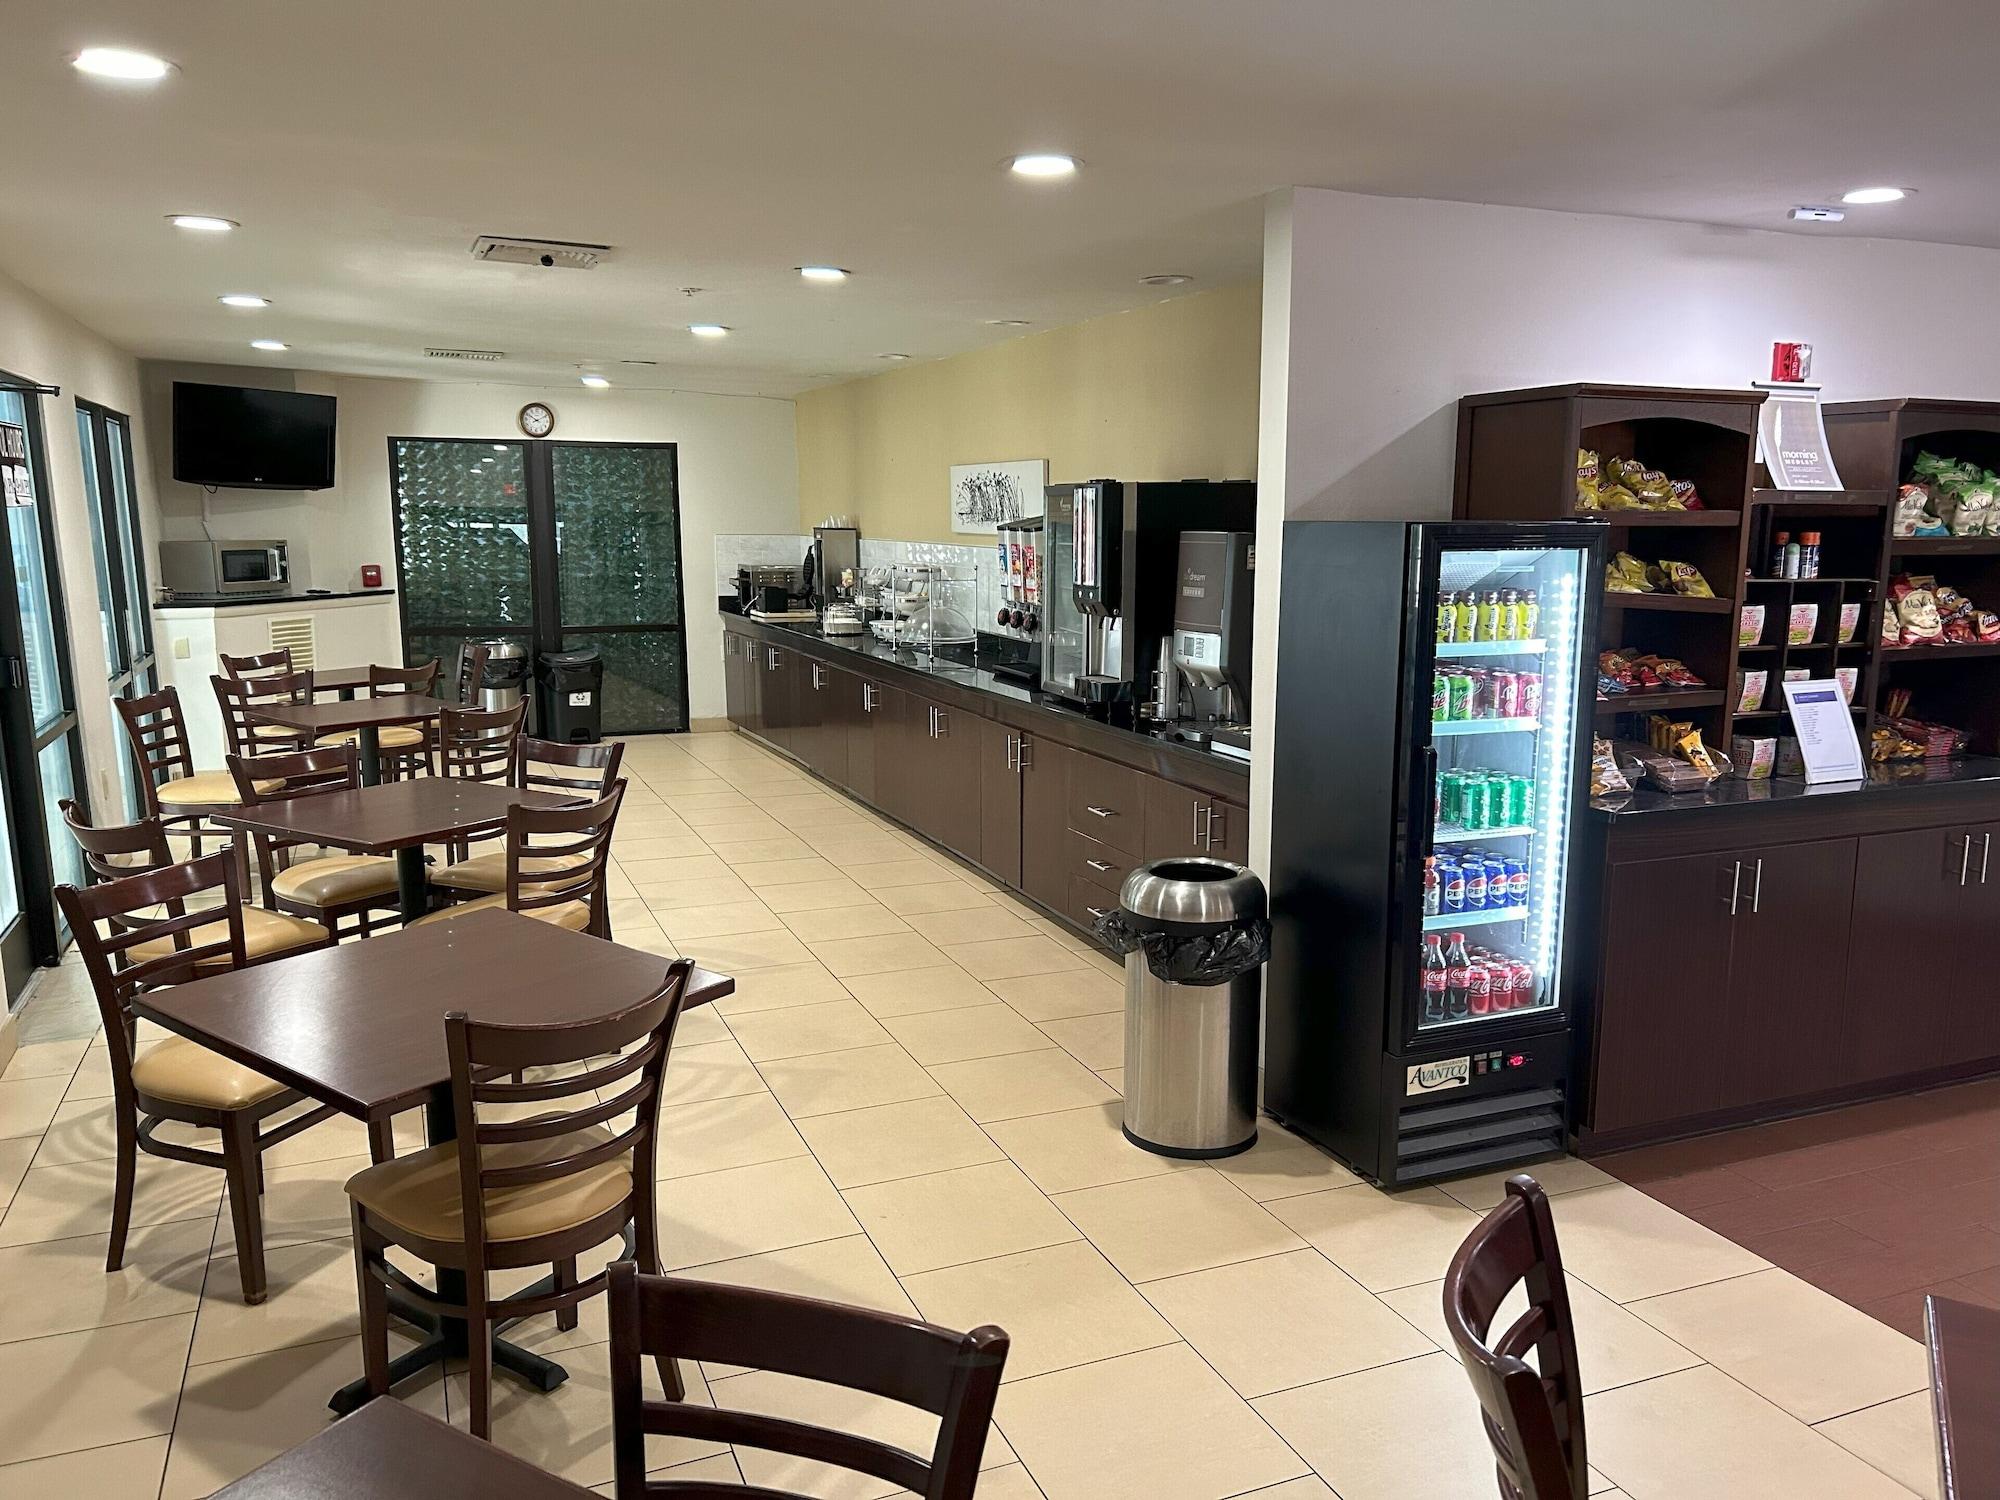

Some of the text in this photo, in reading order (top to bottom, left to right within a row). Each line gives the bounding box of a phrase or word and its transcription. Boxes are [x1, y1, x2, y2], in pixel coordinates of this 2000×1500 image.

[1791, 347, 1800, 376] FIRE
[1782, 449, 1818, 461] morning
[1409, 1064, 1468, 1086] AVANTCO
